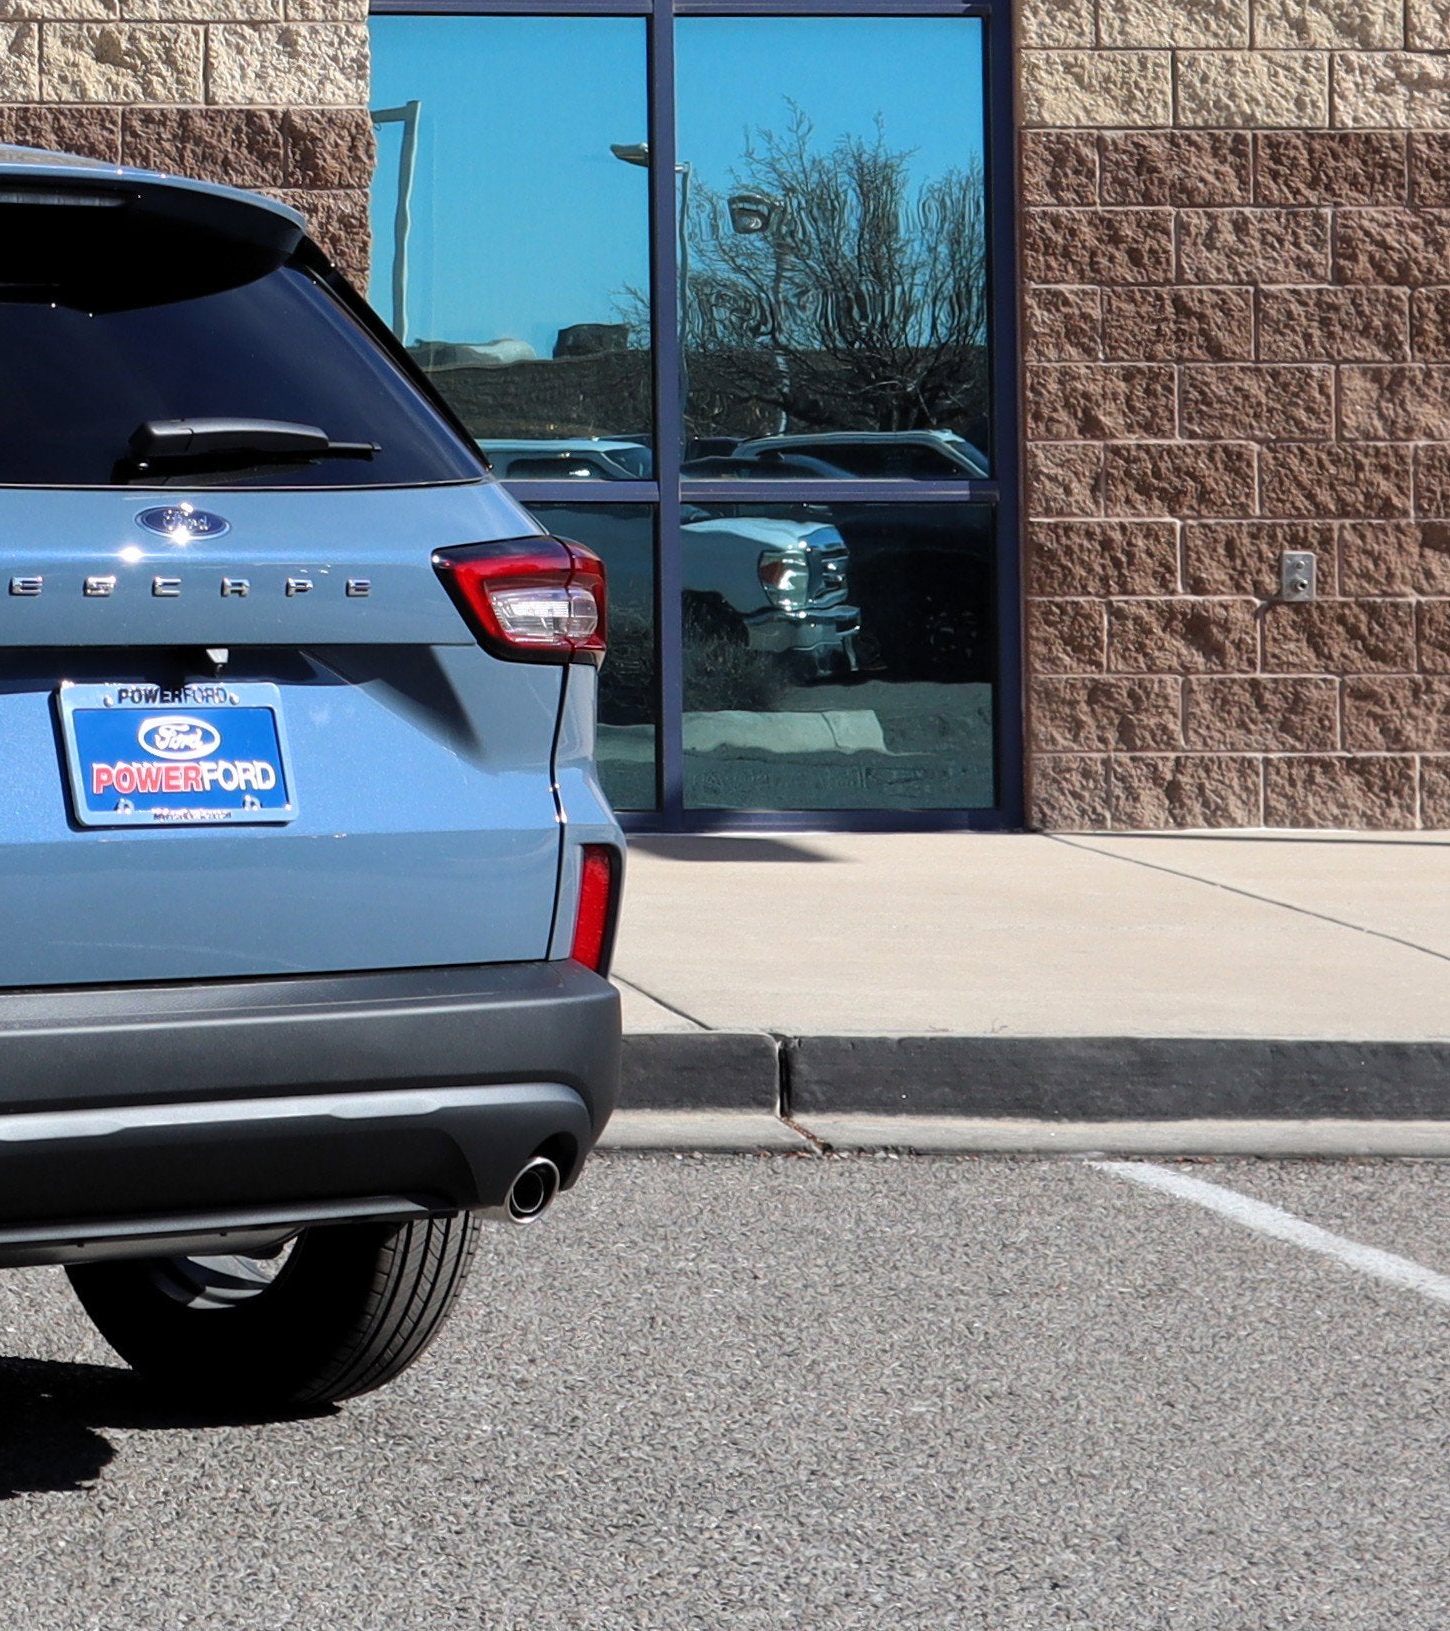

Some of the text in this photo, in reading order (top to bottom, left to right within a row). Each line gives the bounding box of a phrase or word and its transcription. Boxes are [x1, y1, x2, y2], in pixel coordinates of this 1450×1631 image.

[8, 575, 372, 598] ESCAPE
[154, 723, 205, 752] Ford
[91, 760, 277, 795] POWERFORD
